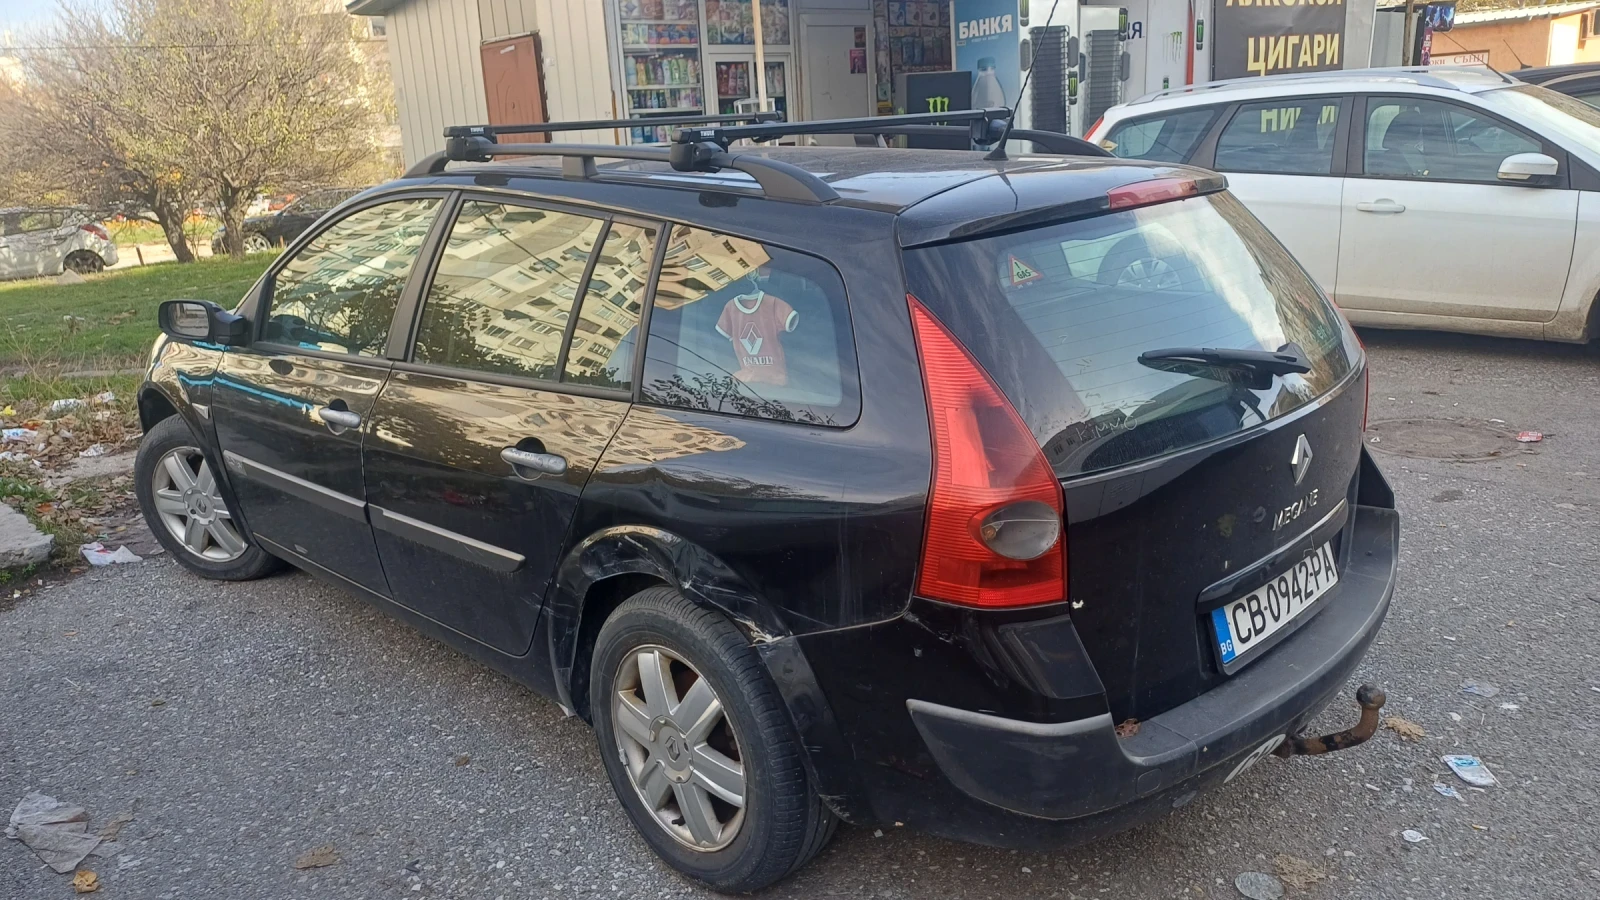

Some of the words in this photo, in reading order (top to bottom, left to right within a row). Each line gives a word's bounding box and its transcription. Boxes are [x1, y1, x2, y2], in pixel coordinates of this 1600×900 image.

[958, 14, 1013, 39] БАНКЯ
[1247, 33, 1340, 76] ЦИГАРИ
[1016, 268, 1032, 279] GAS
[1272, 488, 1319, 531] MEGANE
[1220, 640, 1233, 655] BG
